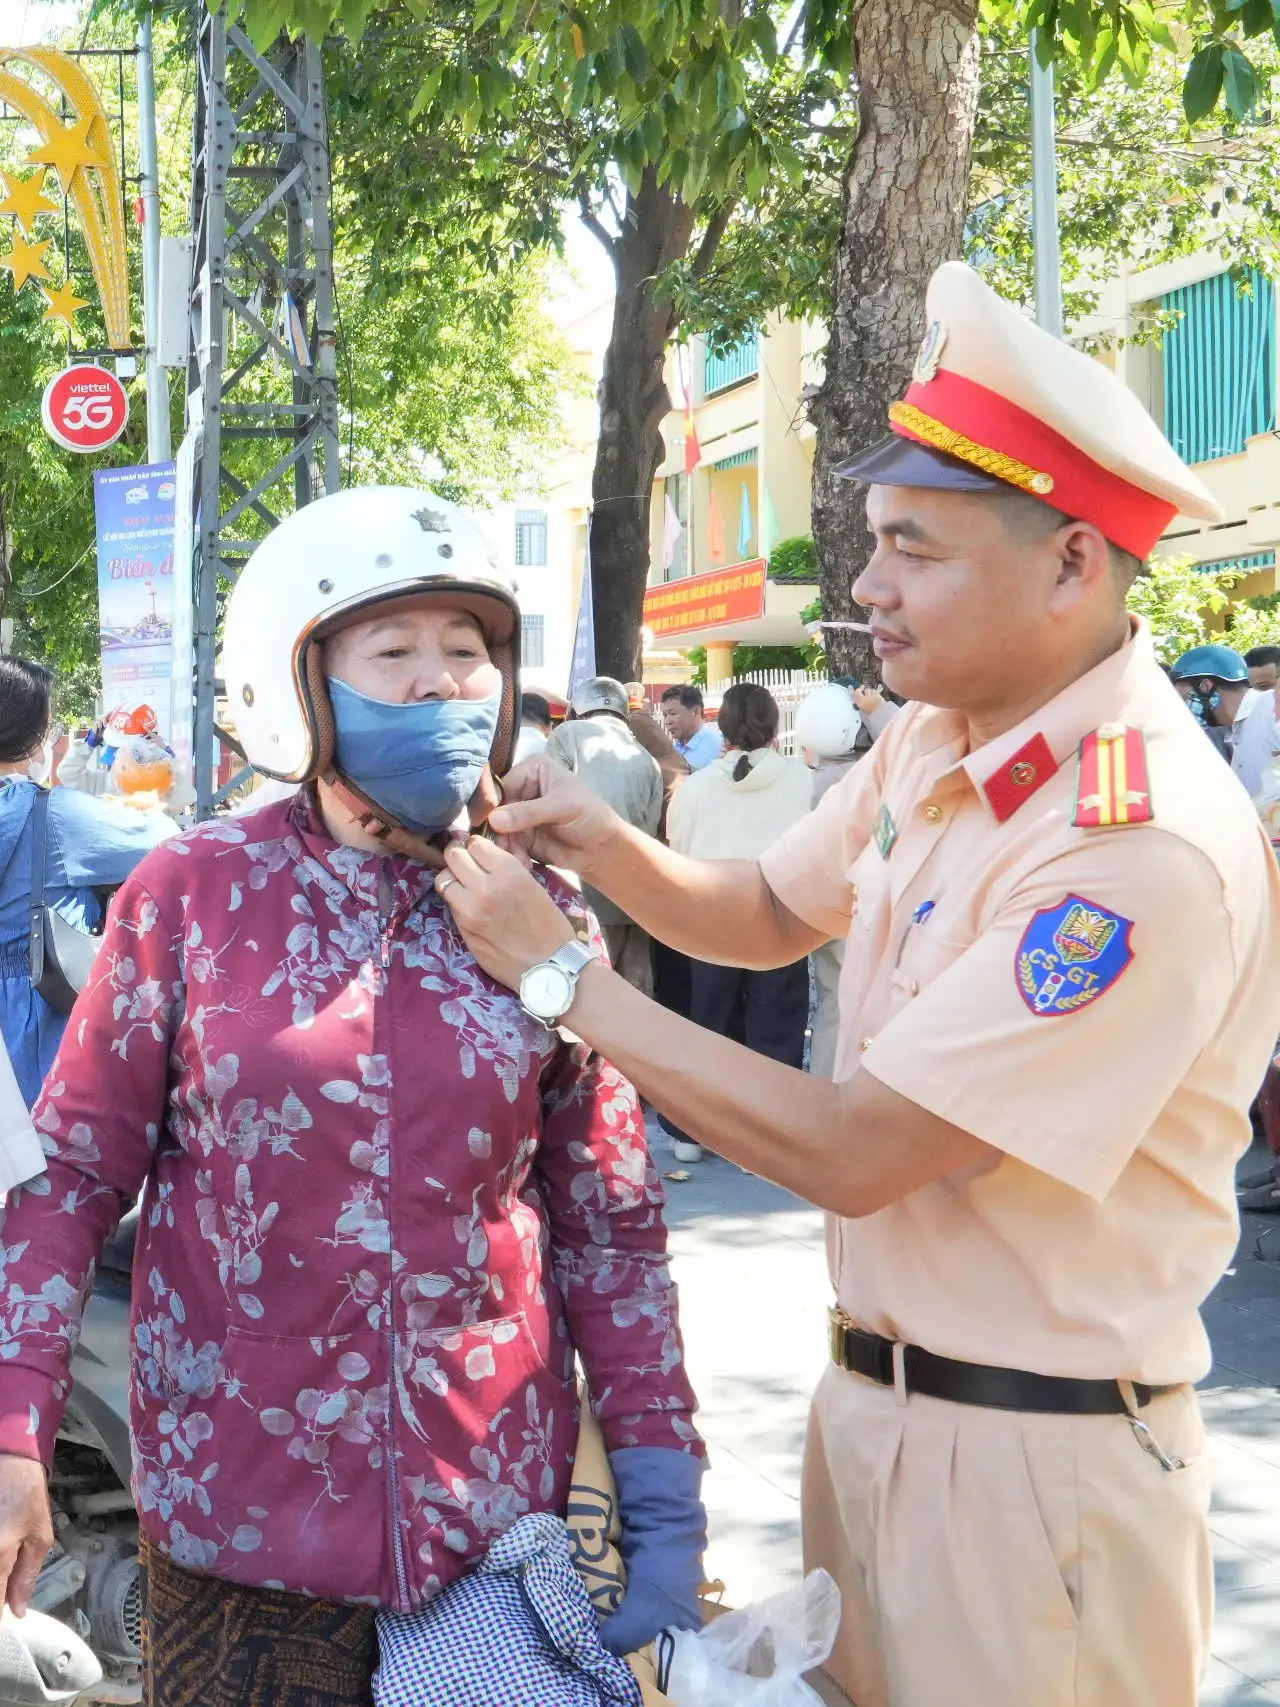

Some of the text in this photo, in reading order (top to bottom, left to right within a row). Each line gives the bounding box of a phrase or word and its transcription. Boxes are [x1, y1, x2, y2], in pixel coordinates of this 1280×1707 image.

[70, 383, 112, 393] viettel
[63, 396, 113, 430] 5G
[1029, 949, 1099, 989] CS GT
